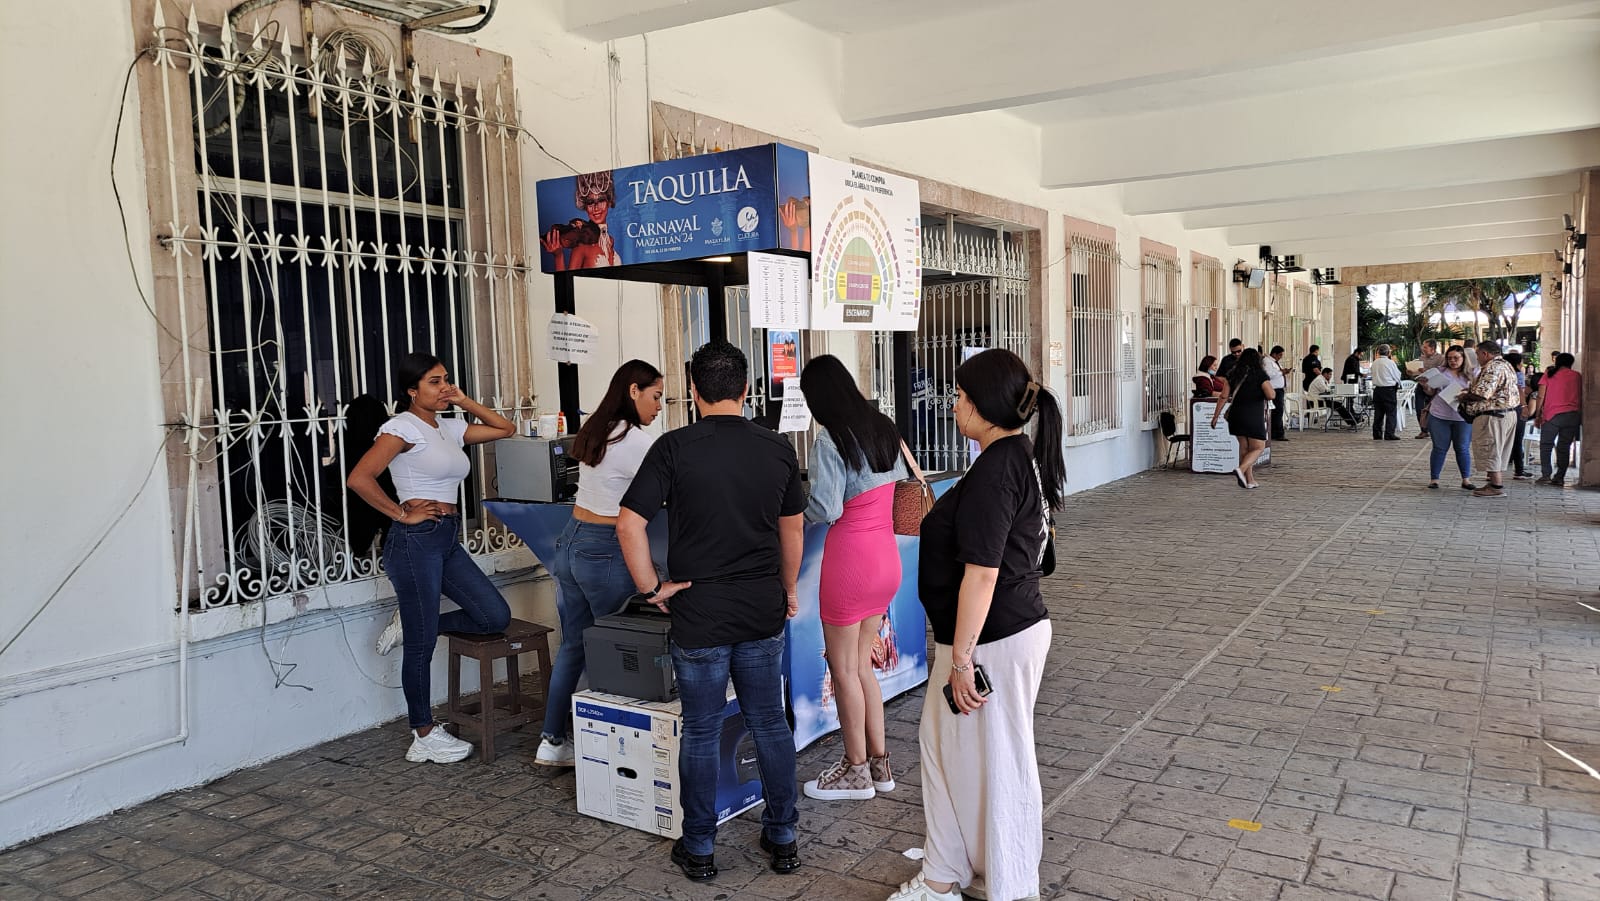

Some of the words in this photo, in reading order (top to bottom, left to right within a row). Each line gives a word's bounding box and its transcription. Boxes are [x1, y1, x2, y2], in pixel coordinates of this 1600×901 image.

[629, 164, 753, 204] TAQUILLA
[626, 215, 701, 238] CARNAVAL
[635, 235, 681, 248] MAZATLÁN
[846, 309, 871, 317] ESCENARIO
